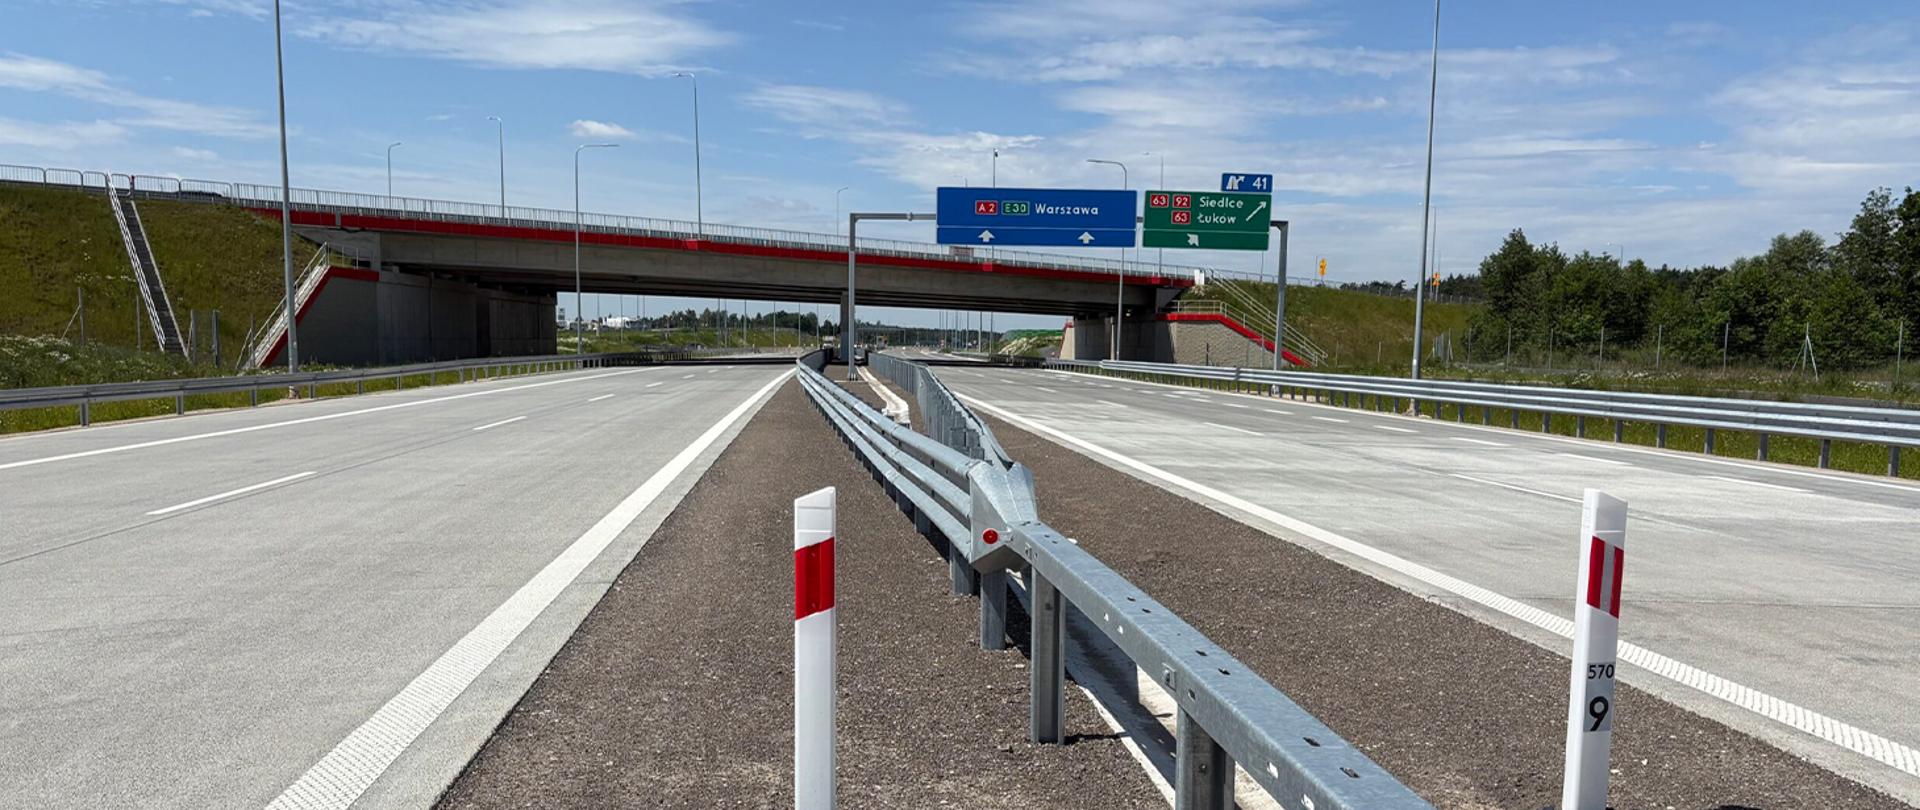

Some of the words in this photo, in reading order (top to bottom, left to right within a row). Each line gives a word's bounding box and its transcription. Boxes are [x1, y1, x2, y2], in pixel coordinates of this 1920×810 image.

[1252, 176, 1267, 190] 41
[1152, 195, 1166, 206] 63
[1175, 197, 1188, 207] 92
[1199, 196, 1244, 208] Siedlce
[1004, 203, 1027, 213] E30
[1035, 203, 1099, 215] Warszawa
[1174, 213, 1188, 222] 63
[1197, 212, 1237, 224] Łuków
[1588, 664, 1614, 679] 570
[1589, 696, 1609, 732] 9
